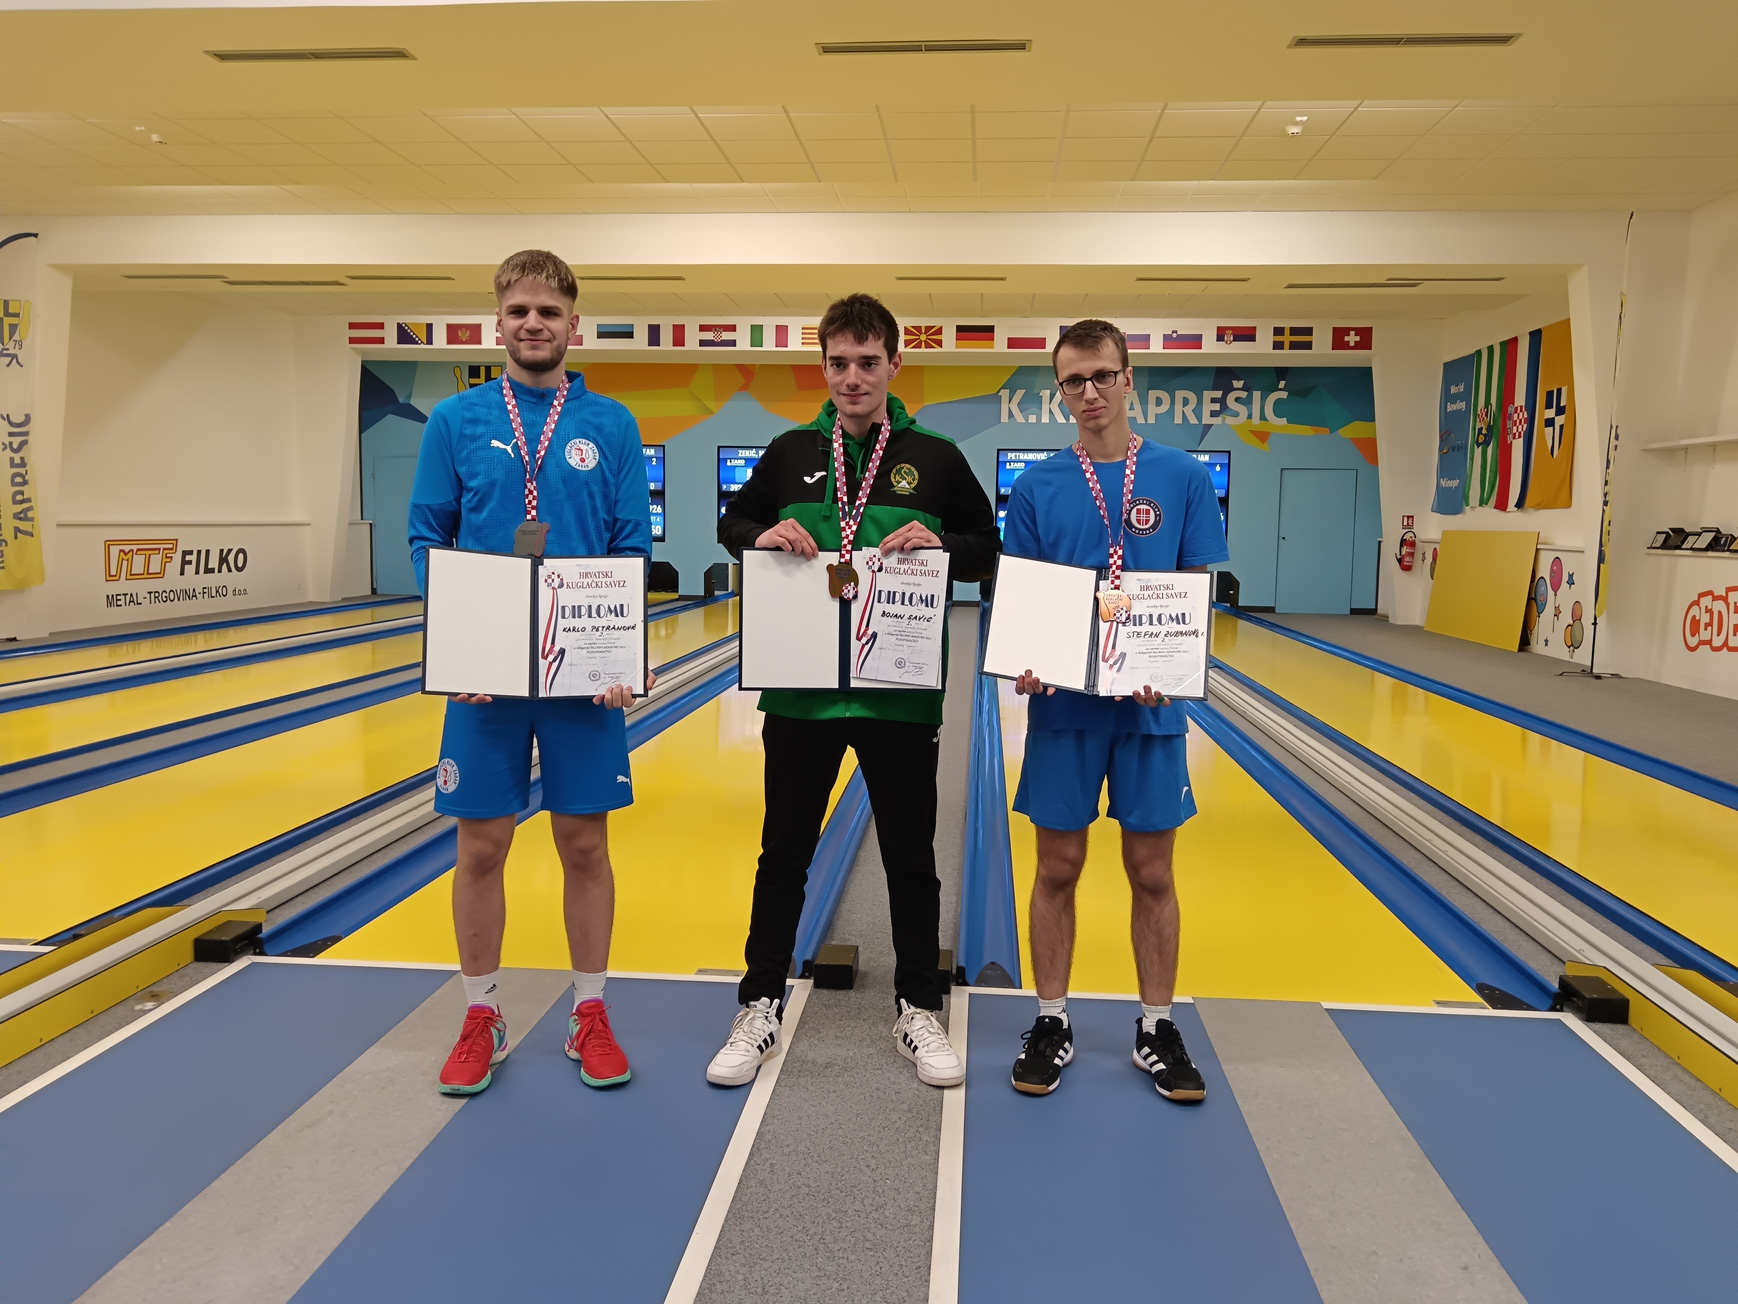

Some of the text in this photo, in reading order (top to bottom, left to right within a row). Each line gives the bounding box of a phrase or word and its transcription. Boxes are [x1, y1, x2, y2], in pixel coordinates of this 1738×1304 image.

[1450, 382, 1464, 394] World
[1124, 380, 1288, 425] APREŠIĆ
[1447, 400, 1466, 412] Bowling
[104, 538, 248, 582] MTF FILKO
[897, 557, 928, 567] HRVATSKI
[579, 570, 613, 579] HRVATSKI
[884, 566, 940, 578] KUGLAČKI SAVEZ
[566, 580, 627, 589] KUGLAČKI SAVEZ
[1139, 584, 1174, 592] HRVATSKI
[232, 586, 249, 596] d.o.o.
[877, 589, 940, 609] DIPLOMU
[561, 603, 630, 620] DIPLOMU
[881, 610, 937, 623] BOJAN SAVIĆ
[562, 625, 587, 633] KARLO
[1126, 630, 1162, 639] STEFAN
